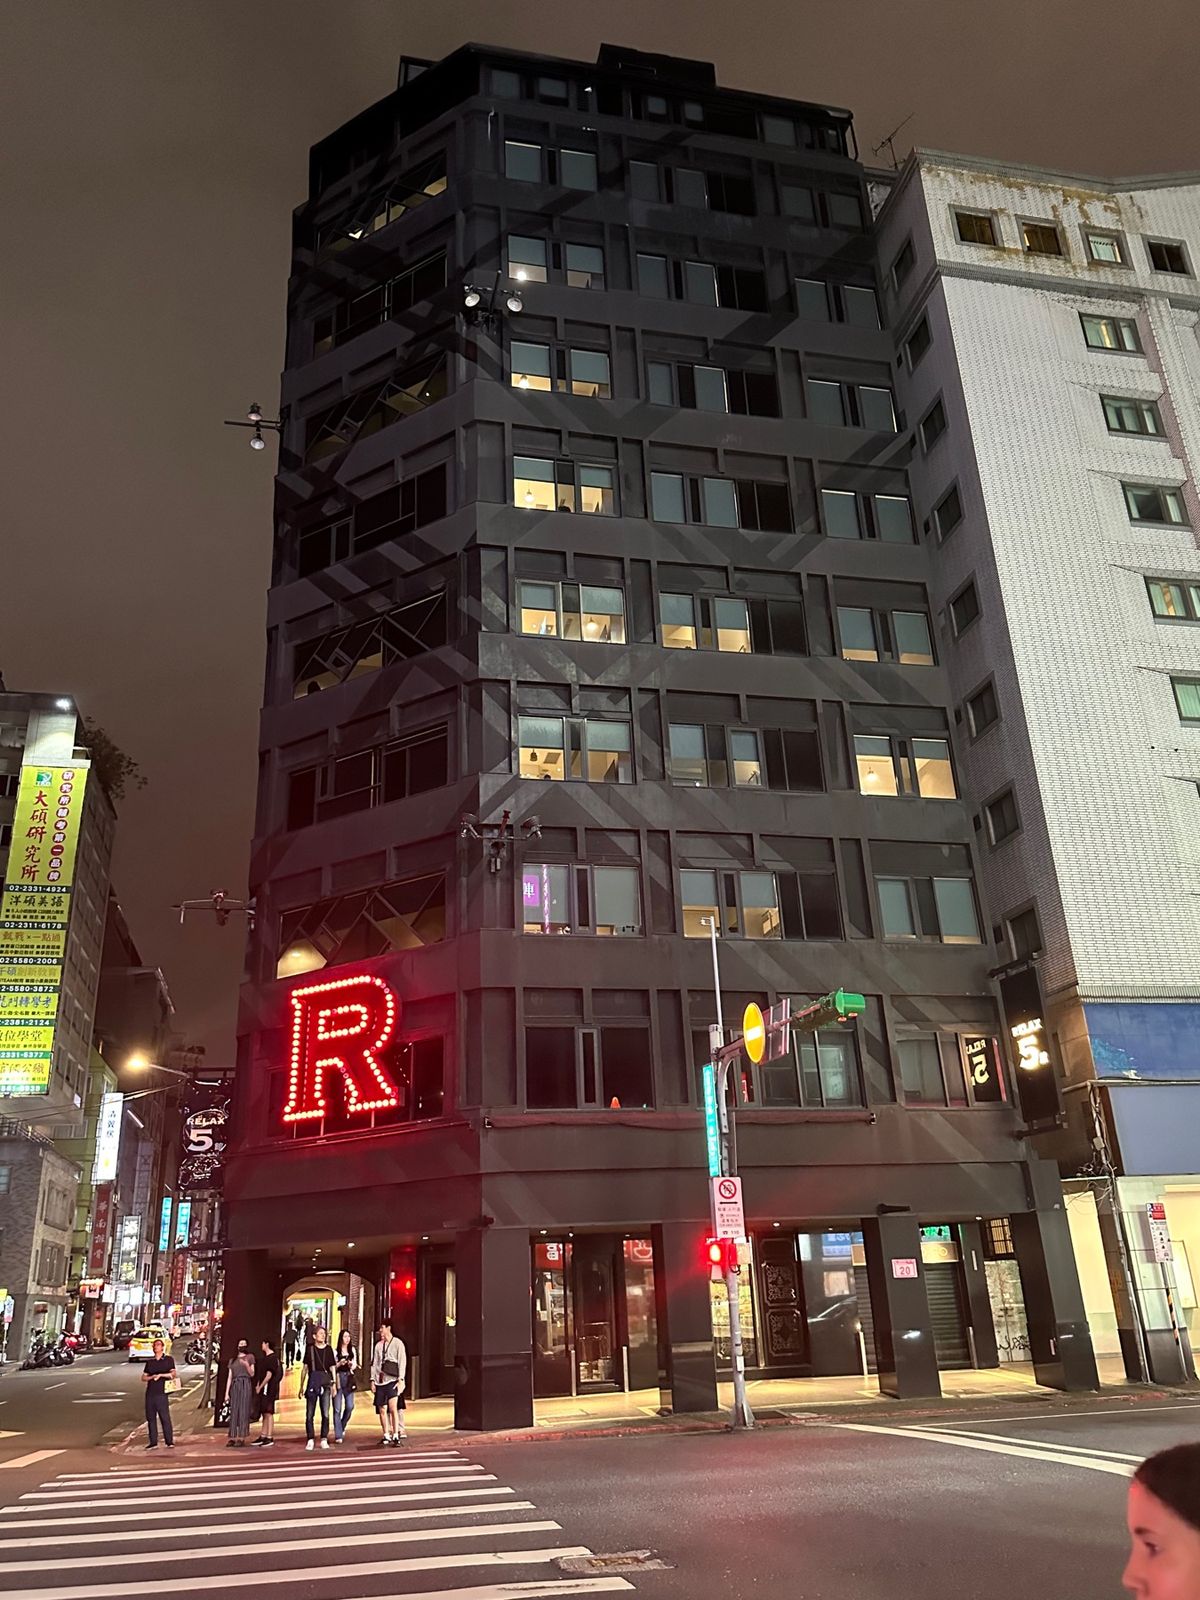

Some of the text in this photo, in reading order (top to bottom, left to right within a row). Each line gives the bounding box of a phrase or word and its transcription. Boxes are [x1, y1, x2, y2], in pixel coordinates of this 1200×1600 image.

[21, 790, 48, 882] 大碩研究所
[283, 975, 399, 1122] R
[1017, 1034, 1039, 1070] 5
[186, 1116, 225, 1126] RELAX
[187, 1128, 214, 1152] 5
[899, 1266, 911, 1275] 20
